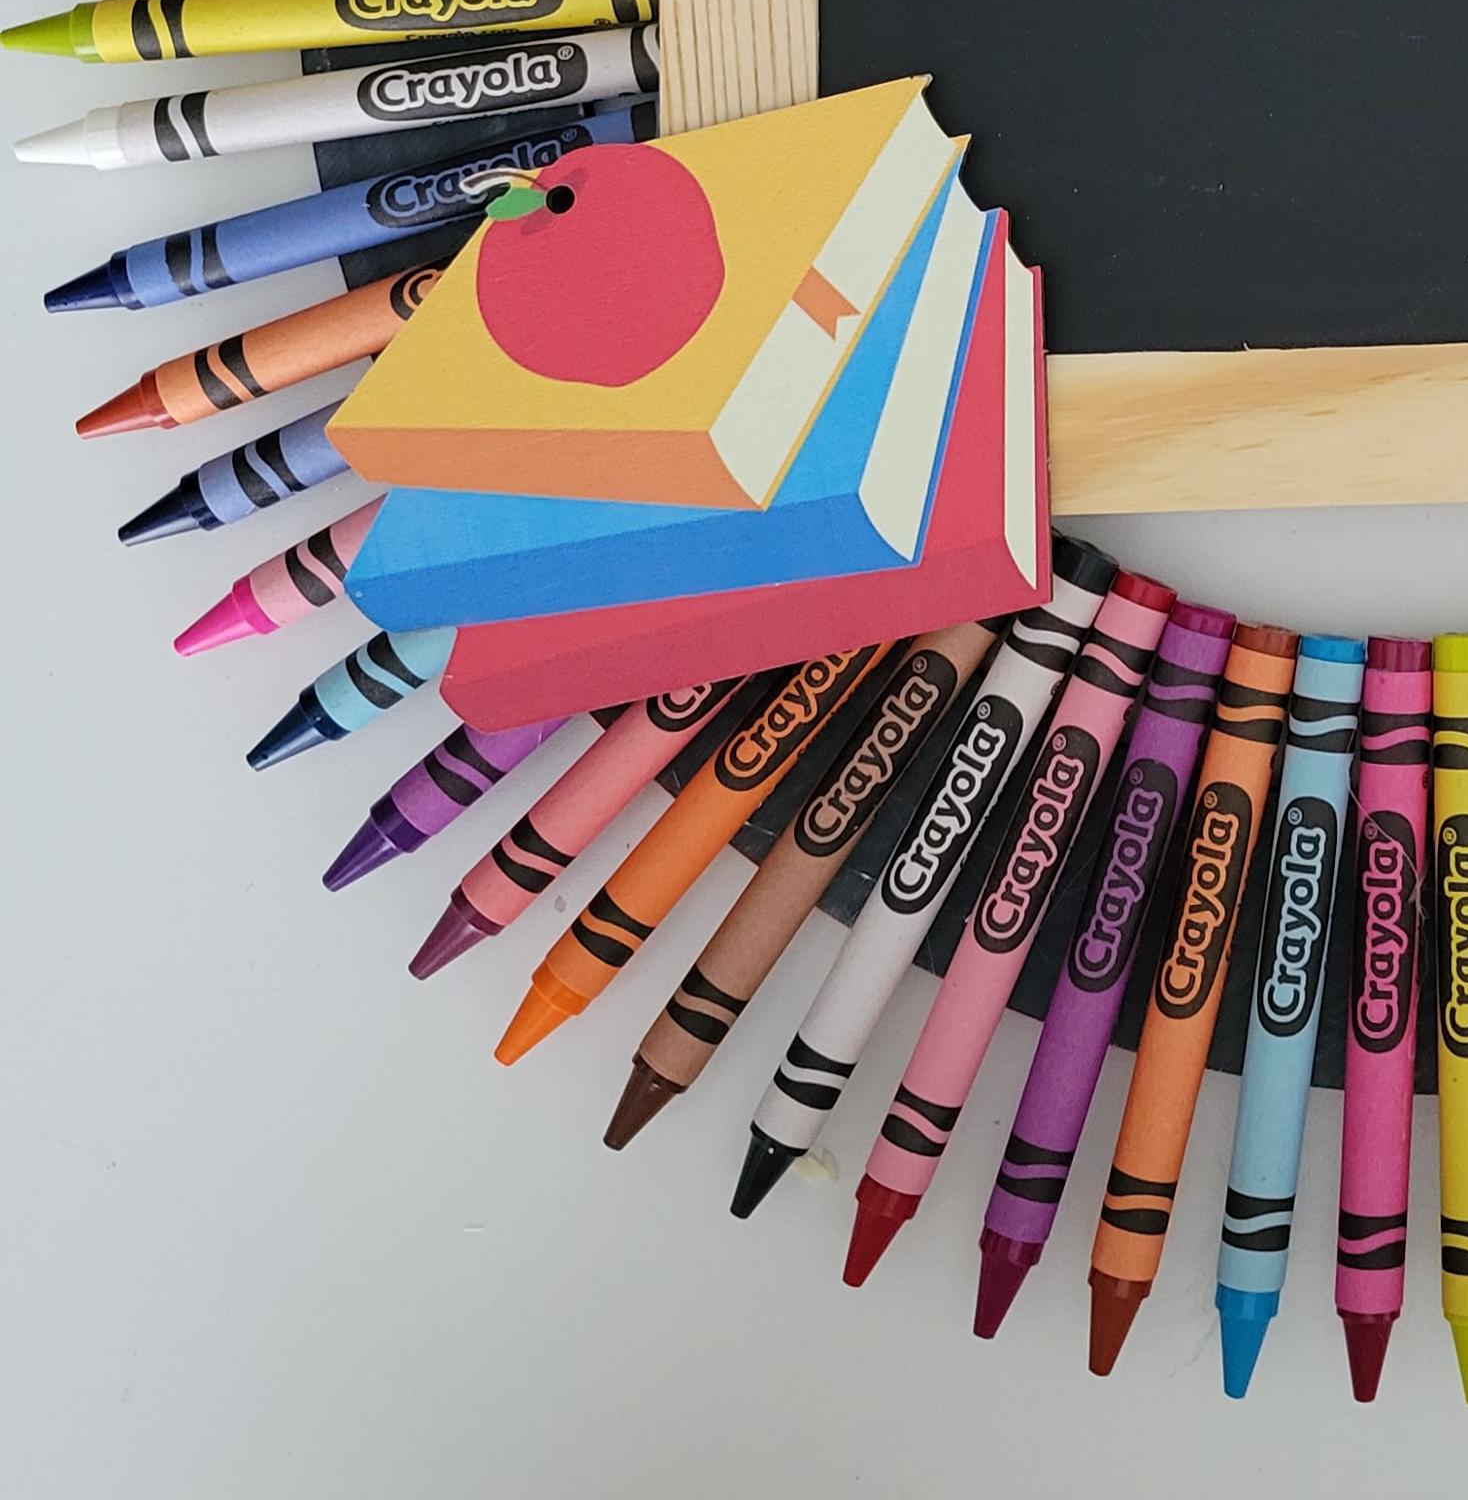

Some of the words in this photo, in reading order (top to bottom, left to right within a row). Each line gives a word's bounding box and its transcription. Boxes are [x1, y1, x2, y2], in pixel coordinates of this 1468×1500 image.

[370, 52, 561, 110] Crayola
[724, 649, 860, 778] Crayo
[804, 678, 939, 844] Crayola
[892, 726, 1007, 902] Crayola
[980, 754, 1085, 940] Crayola
[1075, 788, 1164, 979] Crayola
[1160, 810, 1239, 1006] Crayola
[1262, 826, 1326, 1023] Crayola
[1356, 840, 1408, 1040] Crayola
